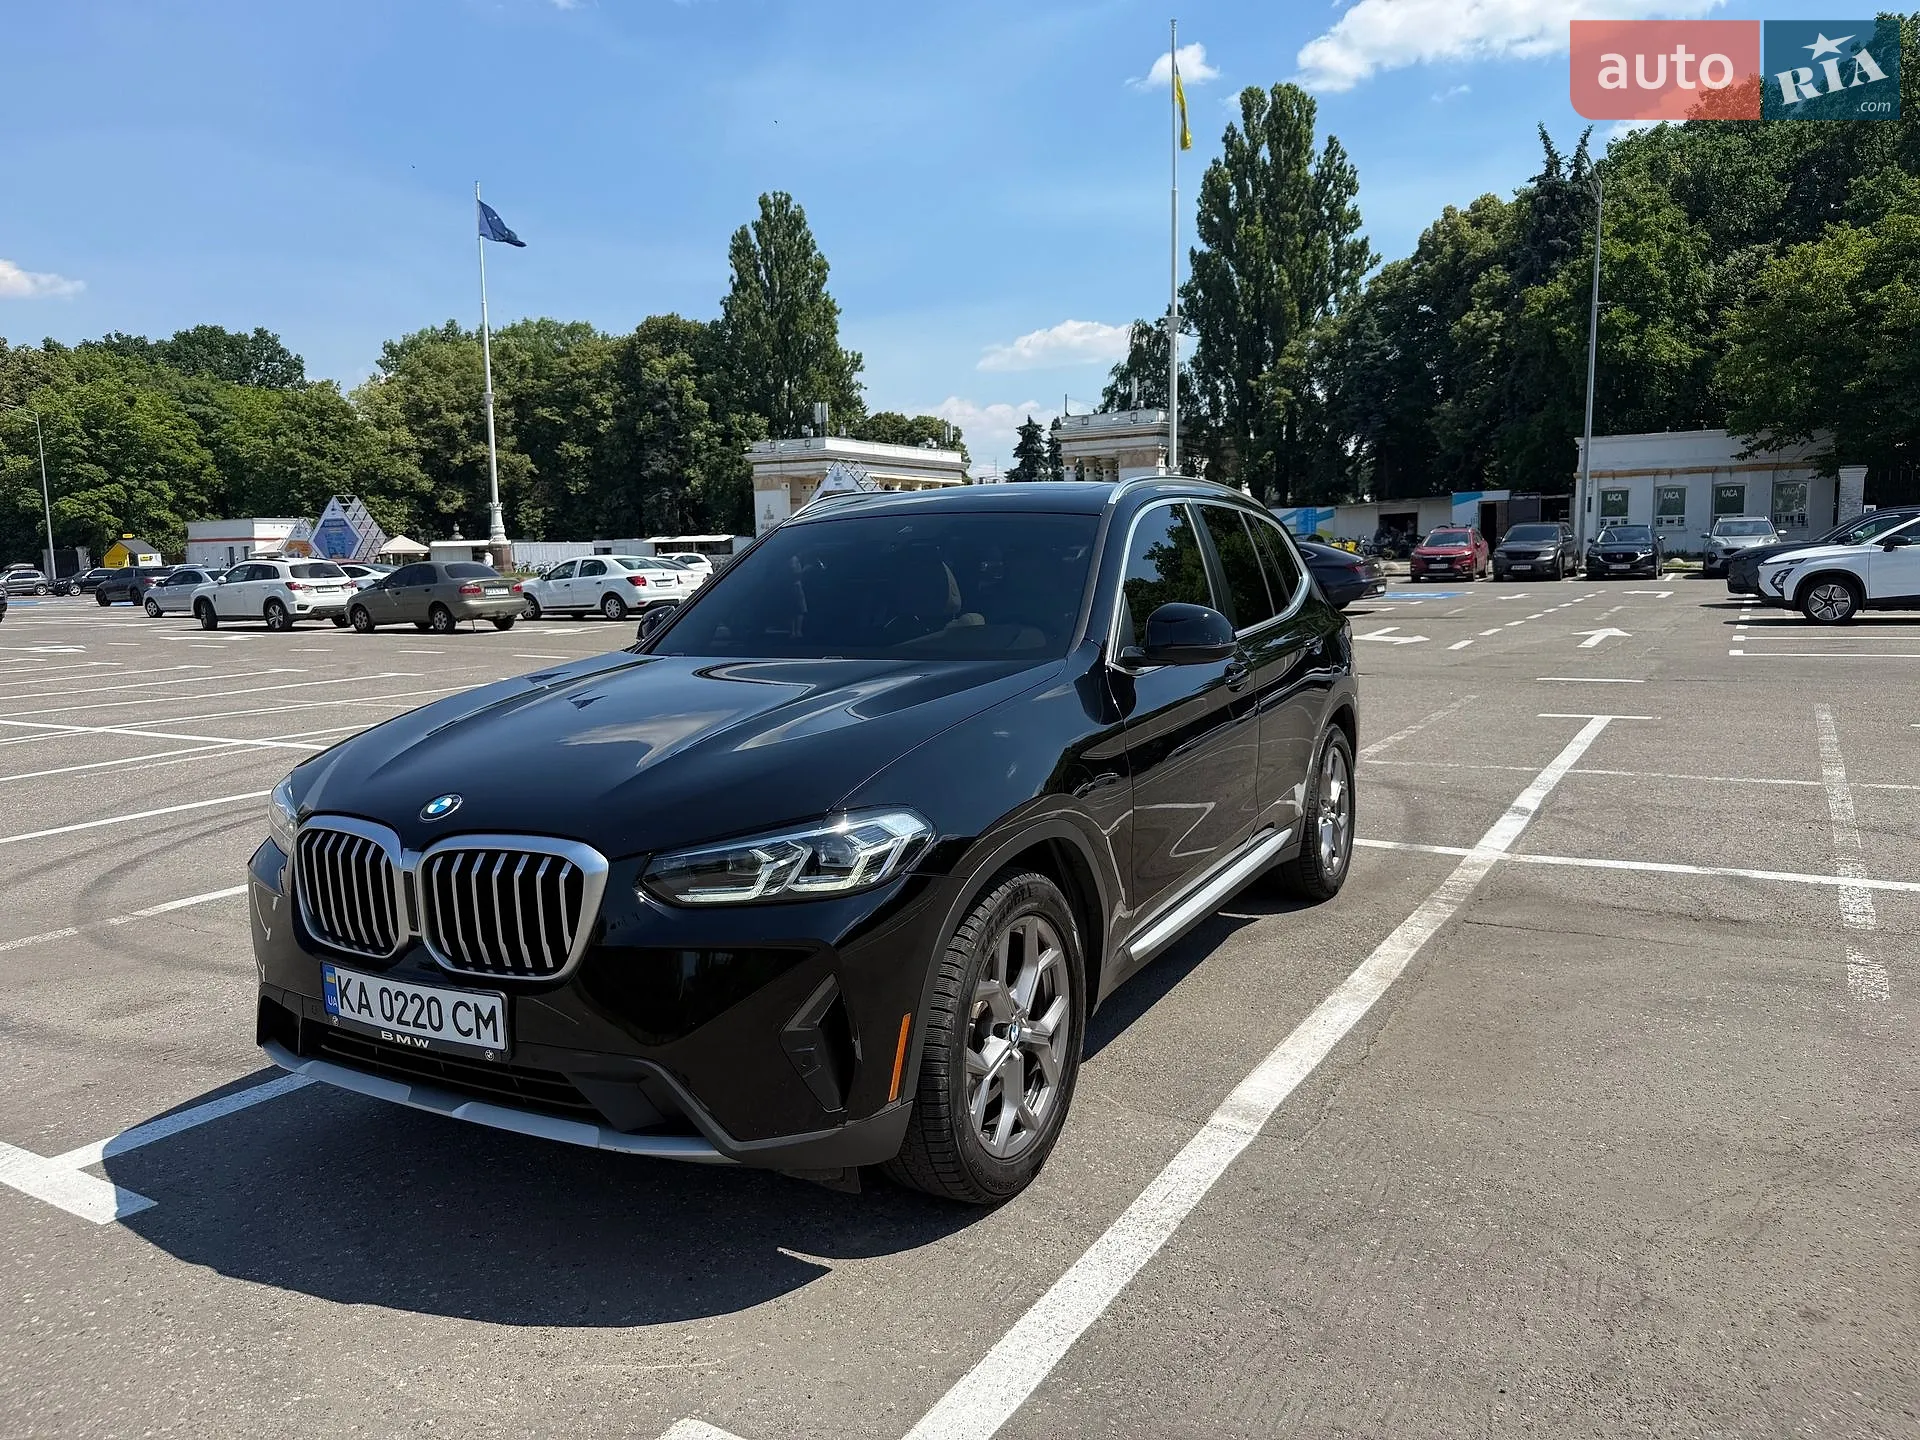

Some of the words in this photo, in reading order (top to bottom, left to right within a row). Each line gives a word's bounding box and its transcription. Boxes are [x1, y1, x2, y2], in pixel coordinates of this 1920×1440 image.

[327, 995, 338, 1008] UA
[337, 975, 374, 1018] KA
[379, 986, 444, 1032] 0220
[452, 1000, 499, 1042] CM
[381, 1030, 430, 1049] BMW
